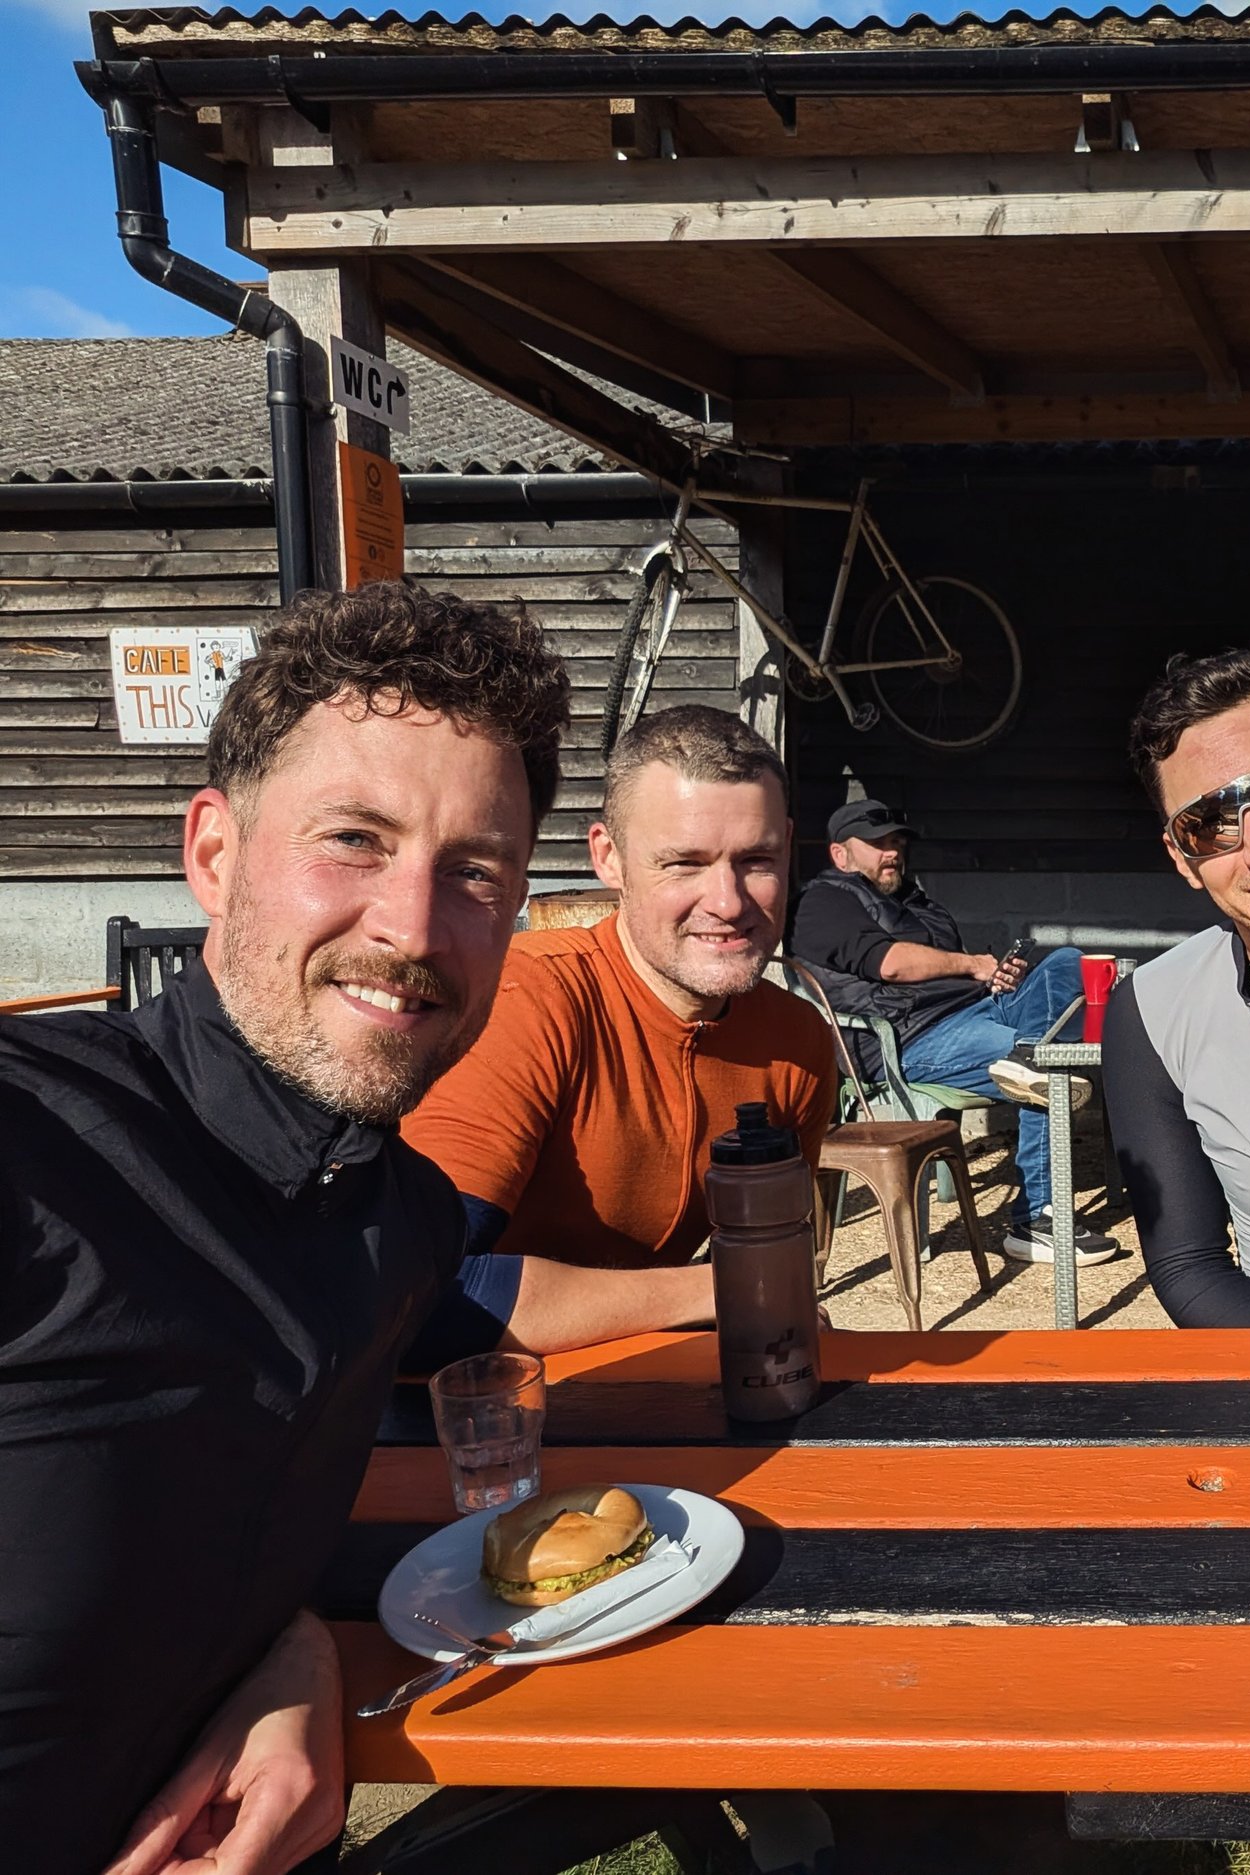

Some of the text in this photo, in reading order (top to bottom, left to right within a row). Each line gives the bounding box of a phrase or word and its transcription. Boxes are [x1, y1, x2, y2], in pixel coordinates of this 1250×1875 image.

[340, 353, 382, 408] WC
[125, 648, 188, 674] CAFE
[126, 685, 194, 729] THIS
[742, 1364, 814, 1389] CUBE
